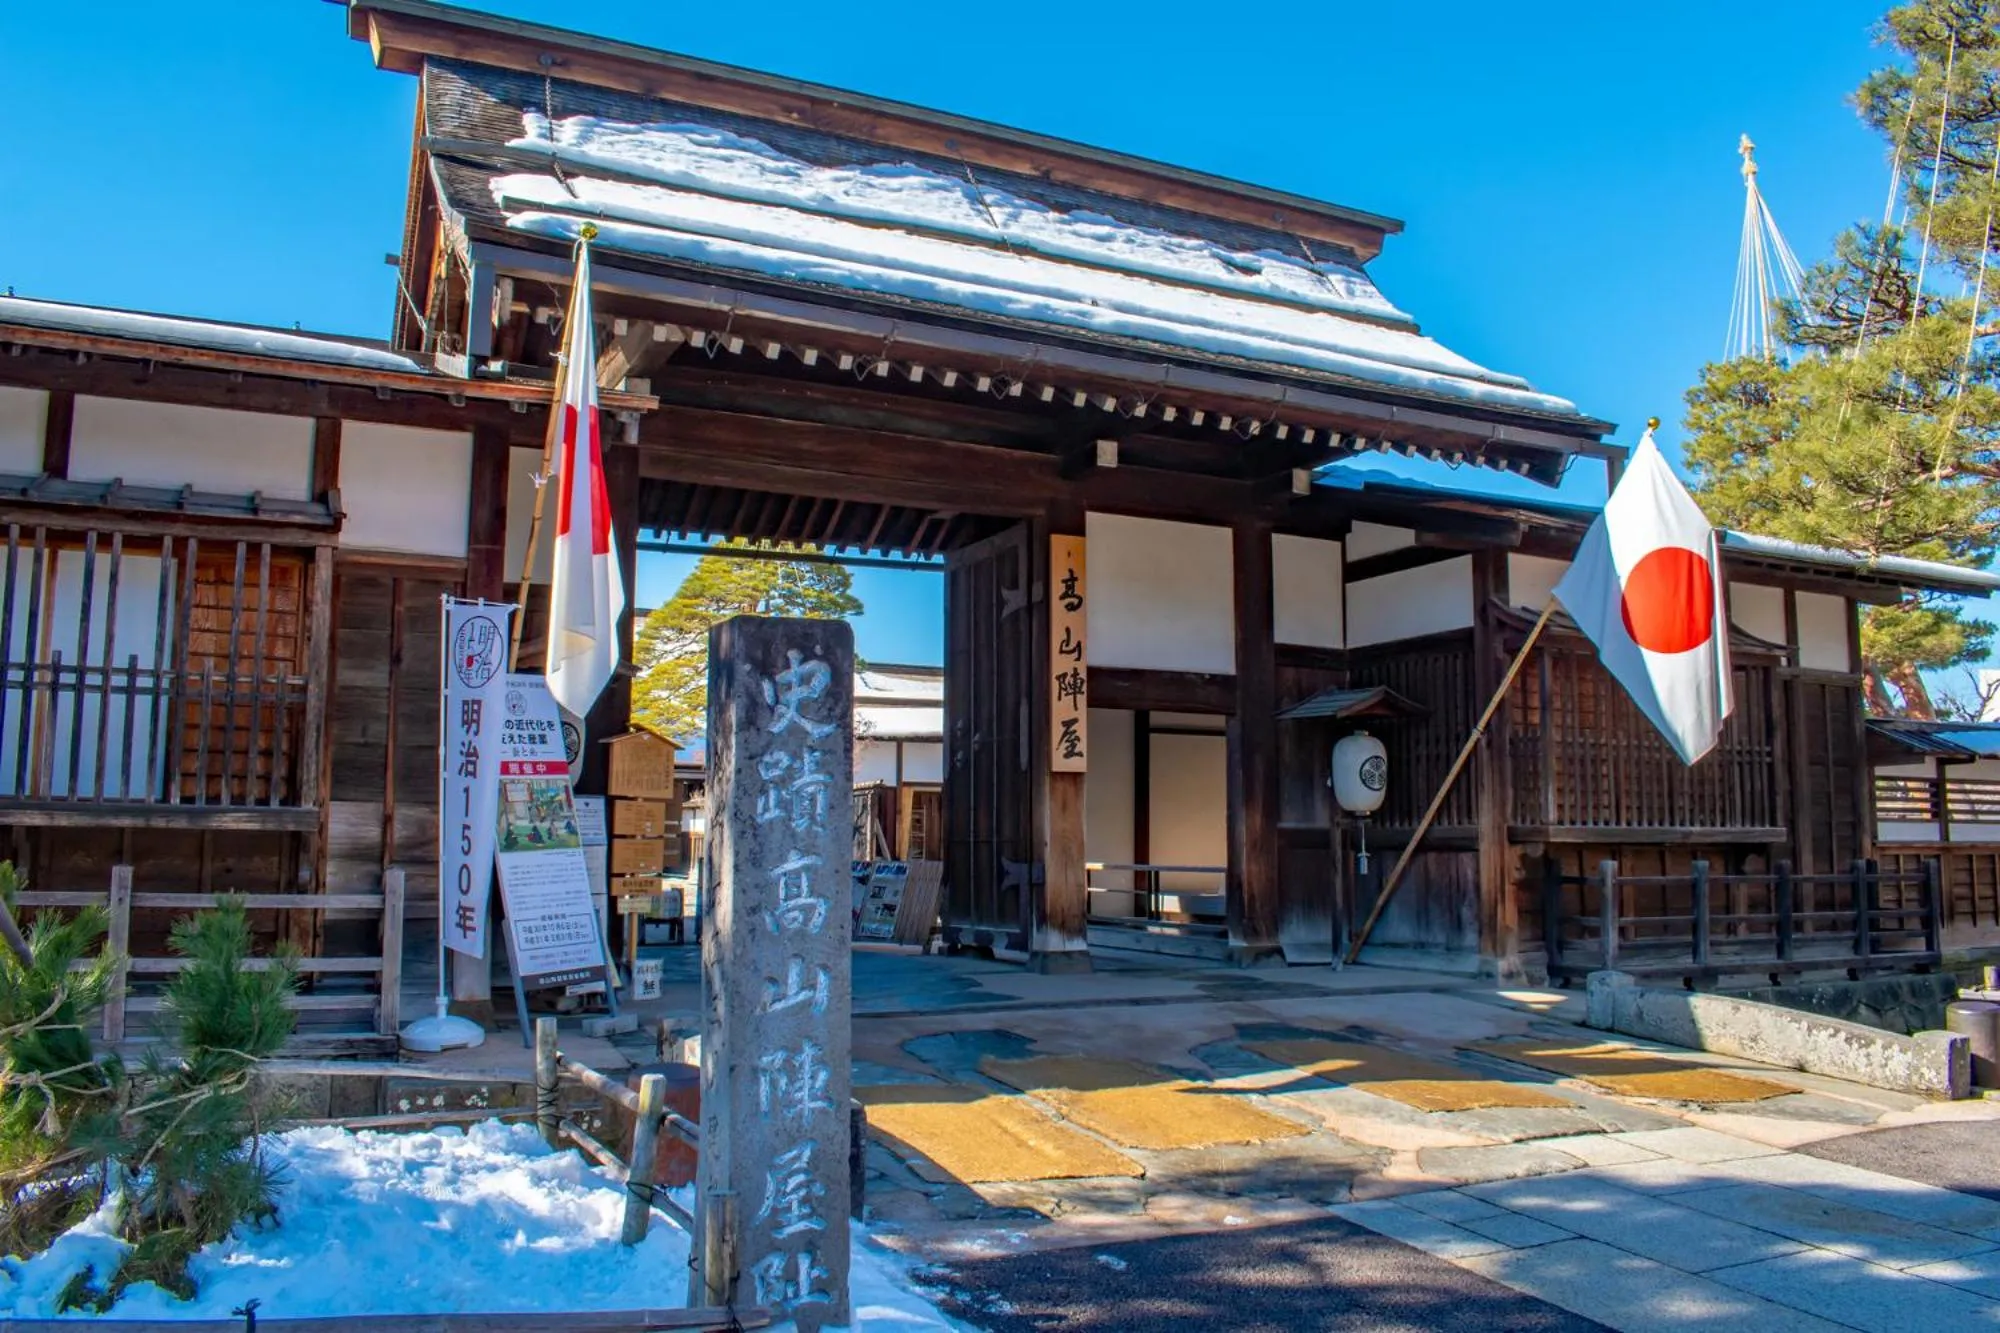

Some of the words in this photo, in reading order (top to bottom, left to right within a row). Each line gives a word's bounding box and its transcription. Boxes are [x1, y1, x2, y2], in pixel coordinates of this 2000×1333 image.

[1055, 568, 1085, 760] 高山陣屋
[455, 699, 482, 939] 明治150年
